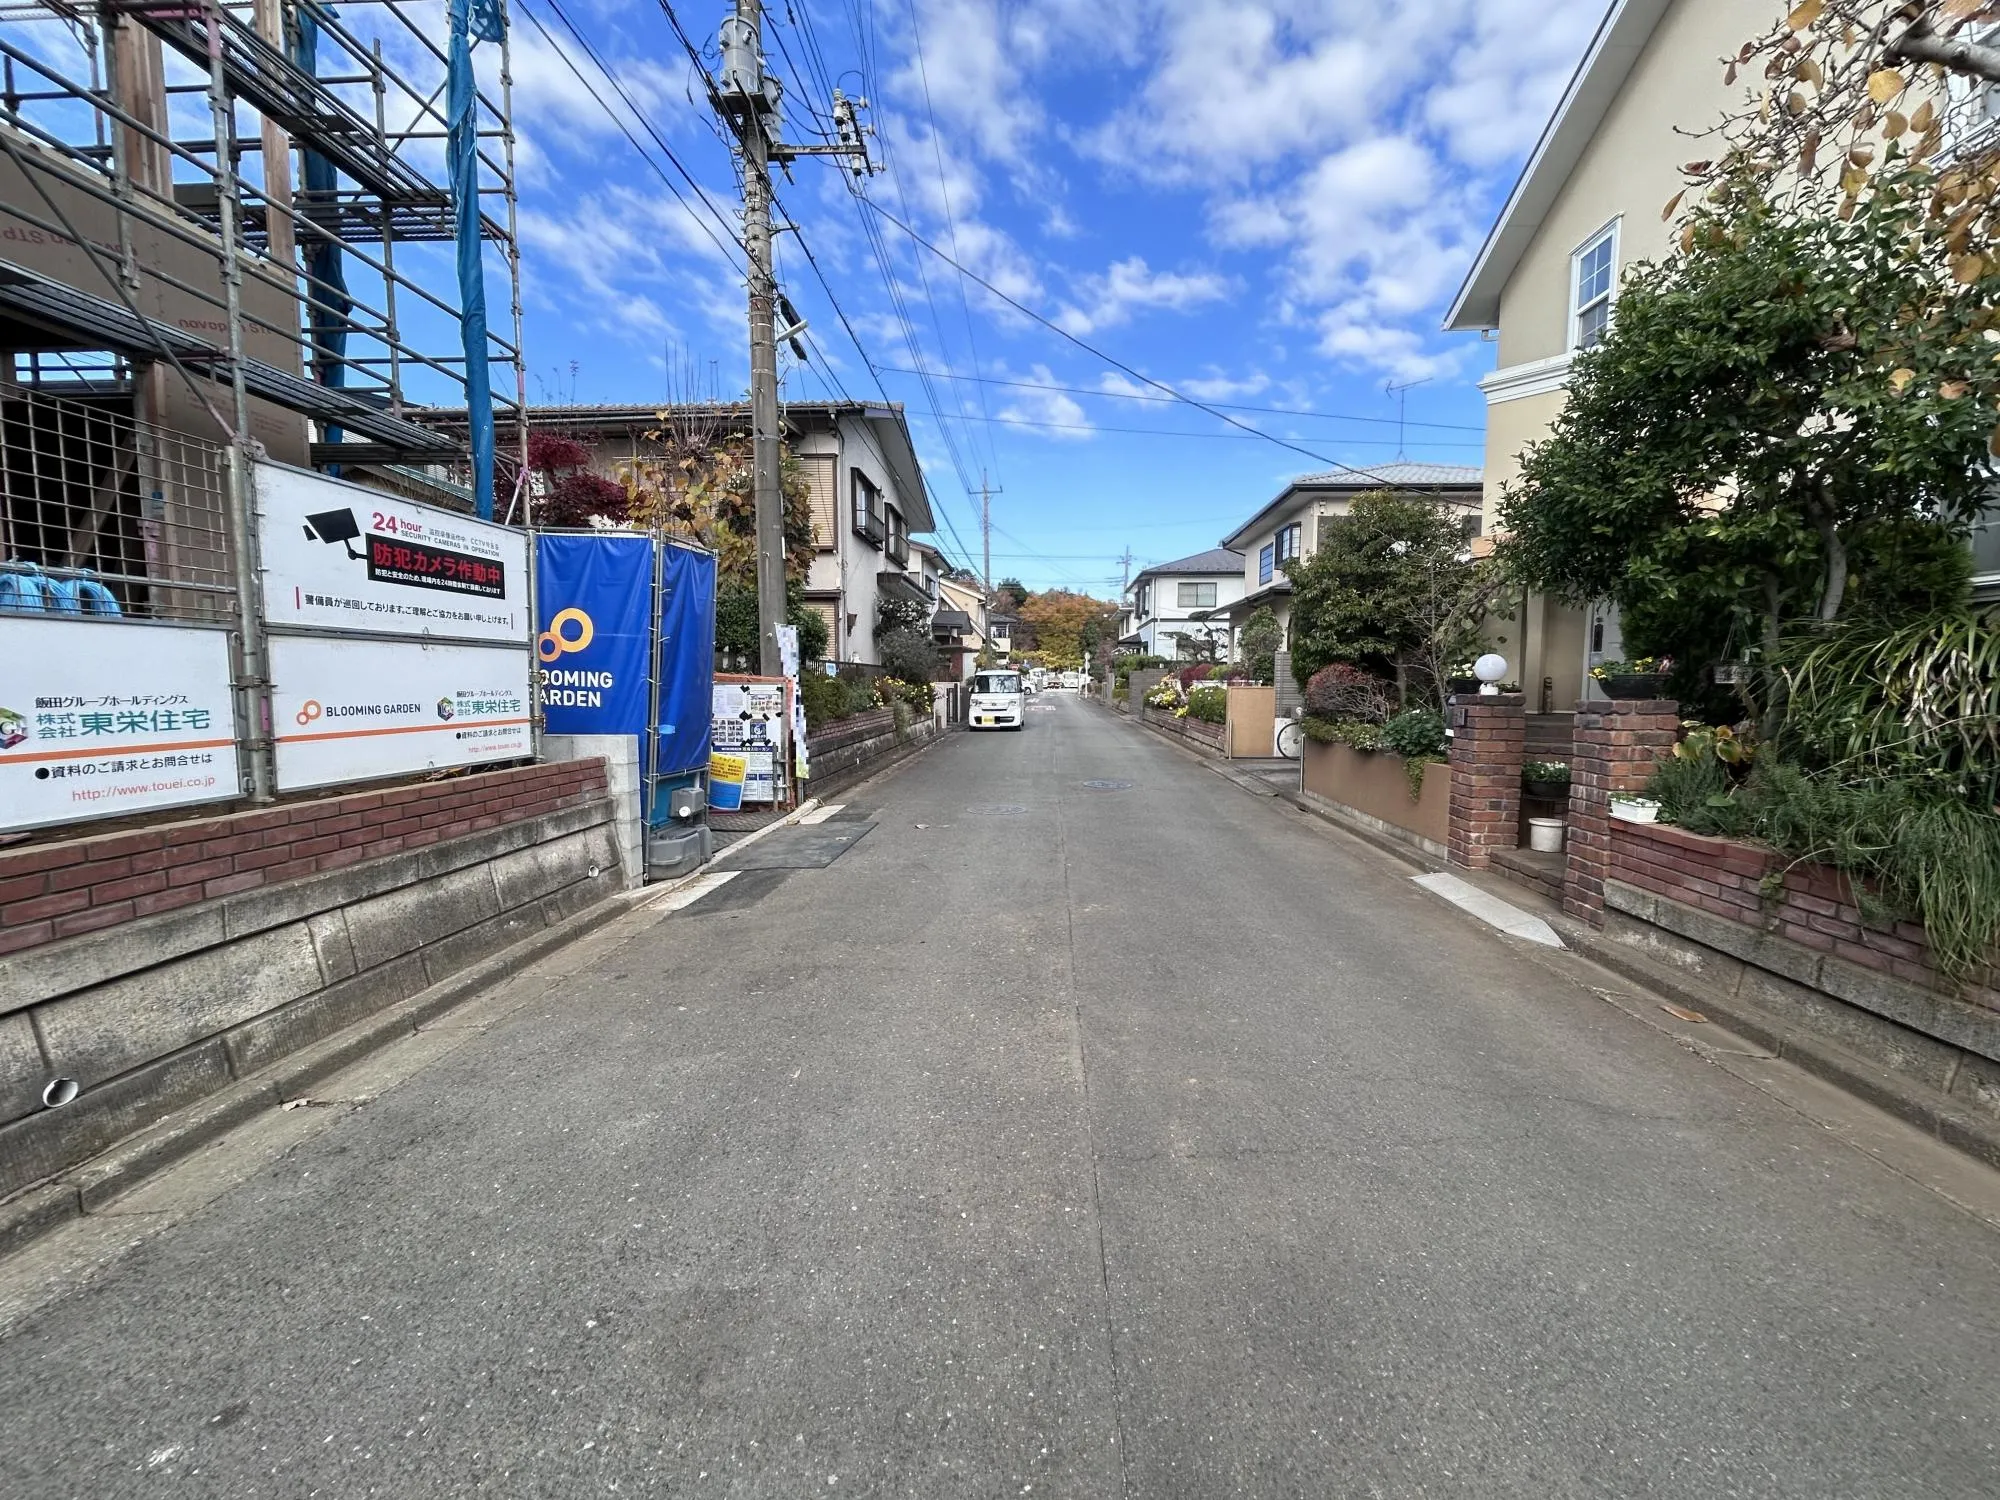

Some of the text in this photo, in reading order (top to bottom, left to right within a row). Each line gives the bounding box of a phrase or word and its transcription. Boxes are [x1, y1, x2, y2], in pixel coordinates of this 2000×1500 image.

[372, 511, 423, 534] 24 hour
[401, 530, 431, 543] SECURITY
[434, 537, 461, 549] CAMERAS
[471, 545, 500, 558] OPERATION
[373, 542, 500, 585] 防犯カメラ作動中
[539, 669, 613, 688] OOMING
[35, 695, 189, 709] 飯田グループホールディングス
[472, 699, 521, 715] 東栄住宅
[539, 689, 601, 708] ARDEN
[326, 703, 421, 717] BLOOMING GARDEN
[78, 708, 211, 736] 東栄住宅
[72, 775, 215, 802] http://www.touei.co.jp
